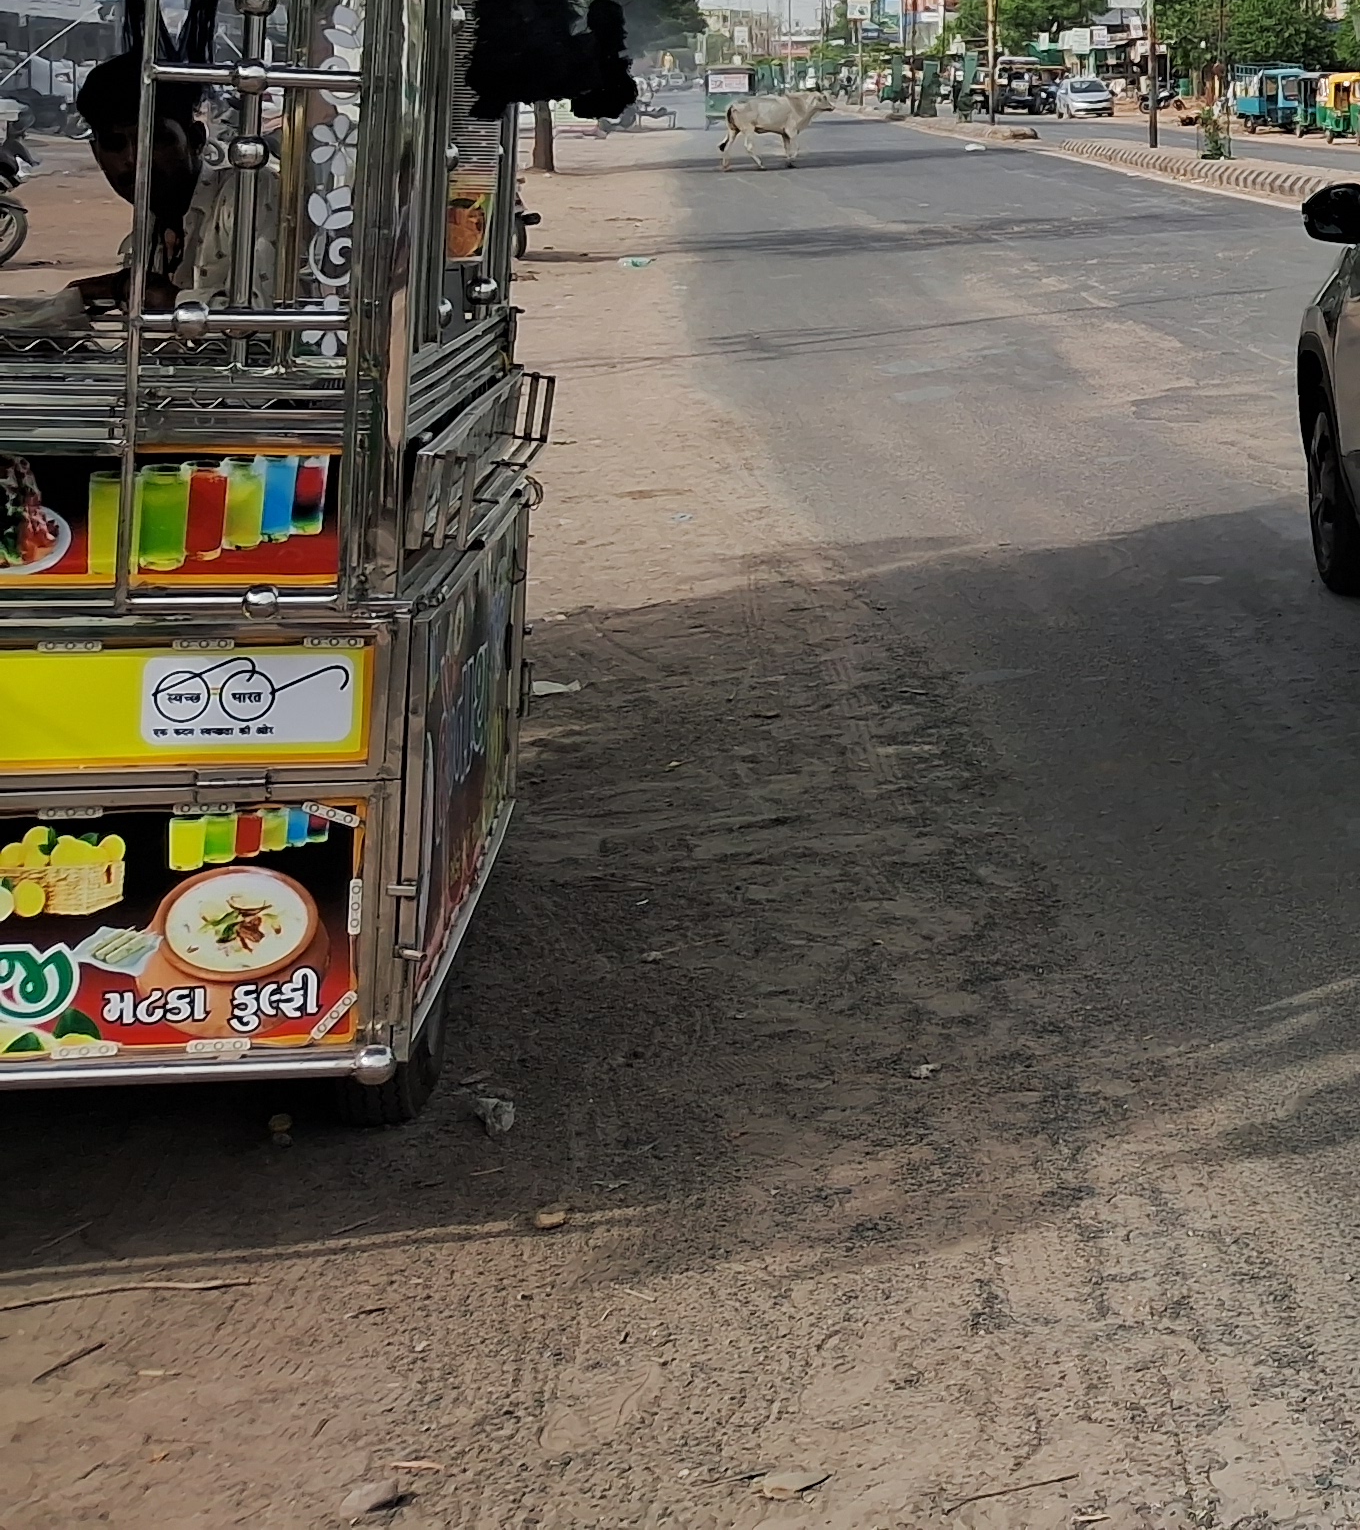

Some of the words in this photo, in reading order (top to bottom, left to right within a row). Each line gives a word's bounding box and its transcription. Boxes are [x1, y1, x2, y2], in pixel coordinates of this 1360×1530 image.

[166, 692, 203, 705] स्वच्छ
[230, 691, 264, 704] भारत
[101, 985, 208, 1025] મટકા
[227, 966, 321, 1033] કુલ્ફી
